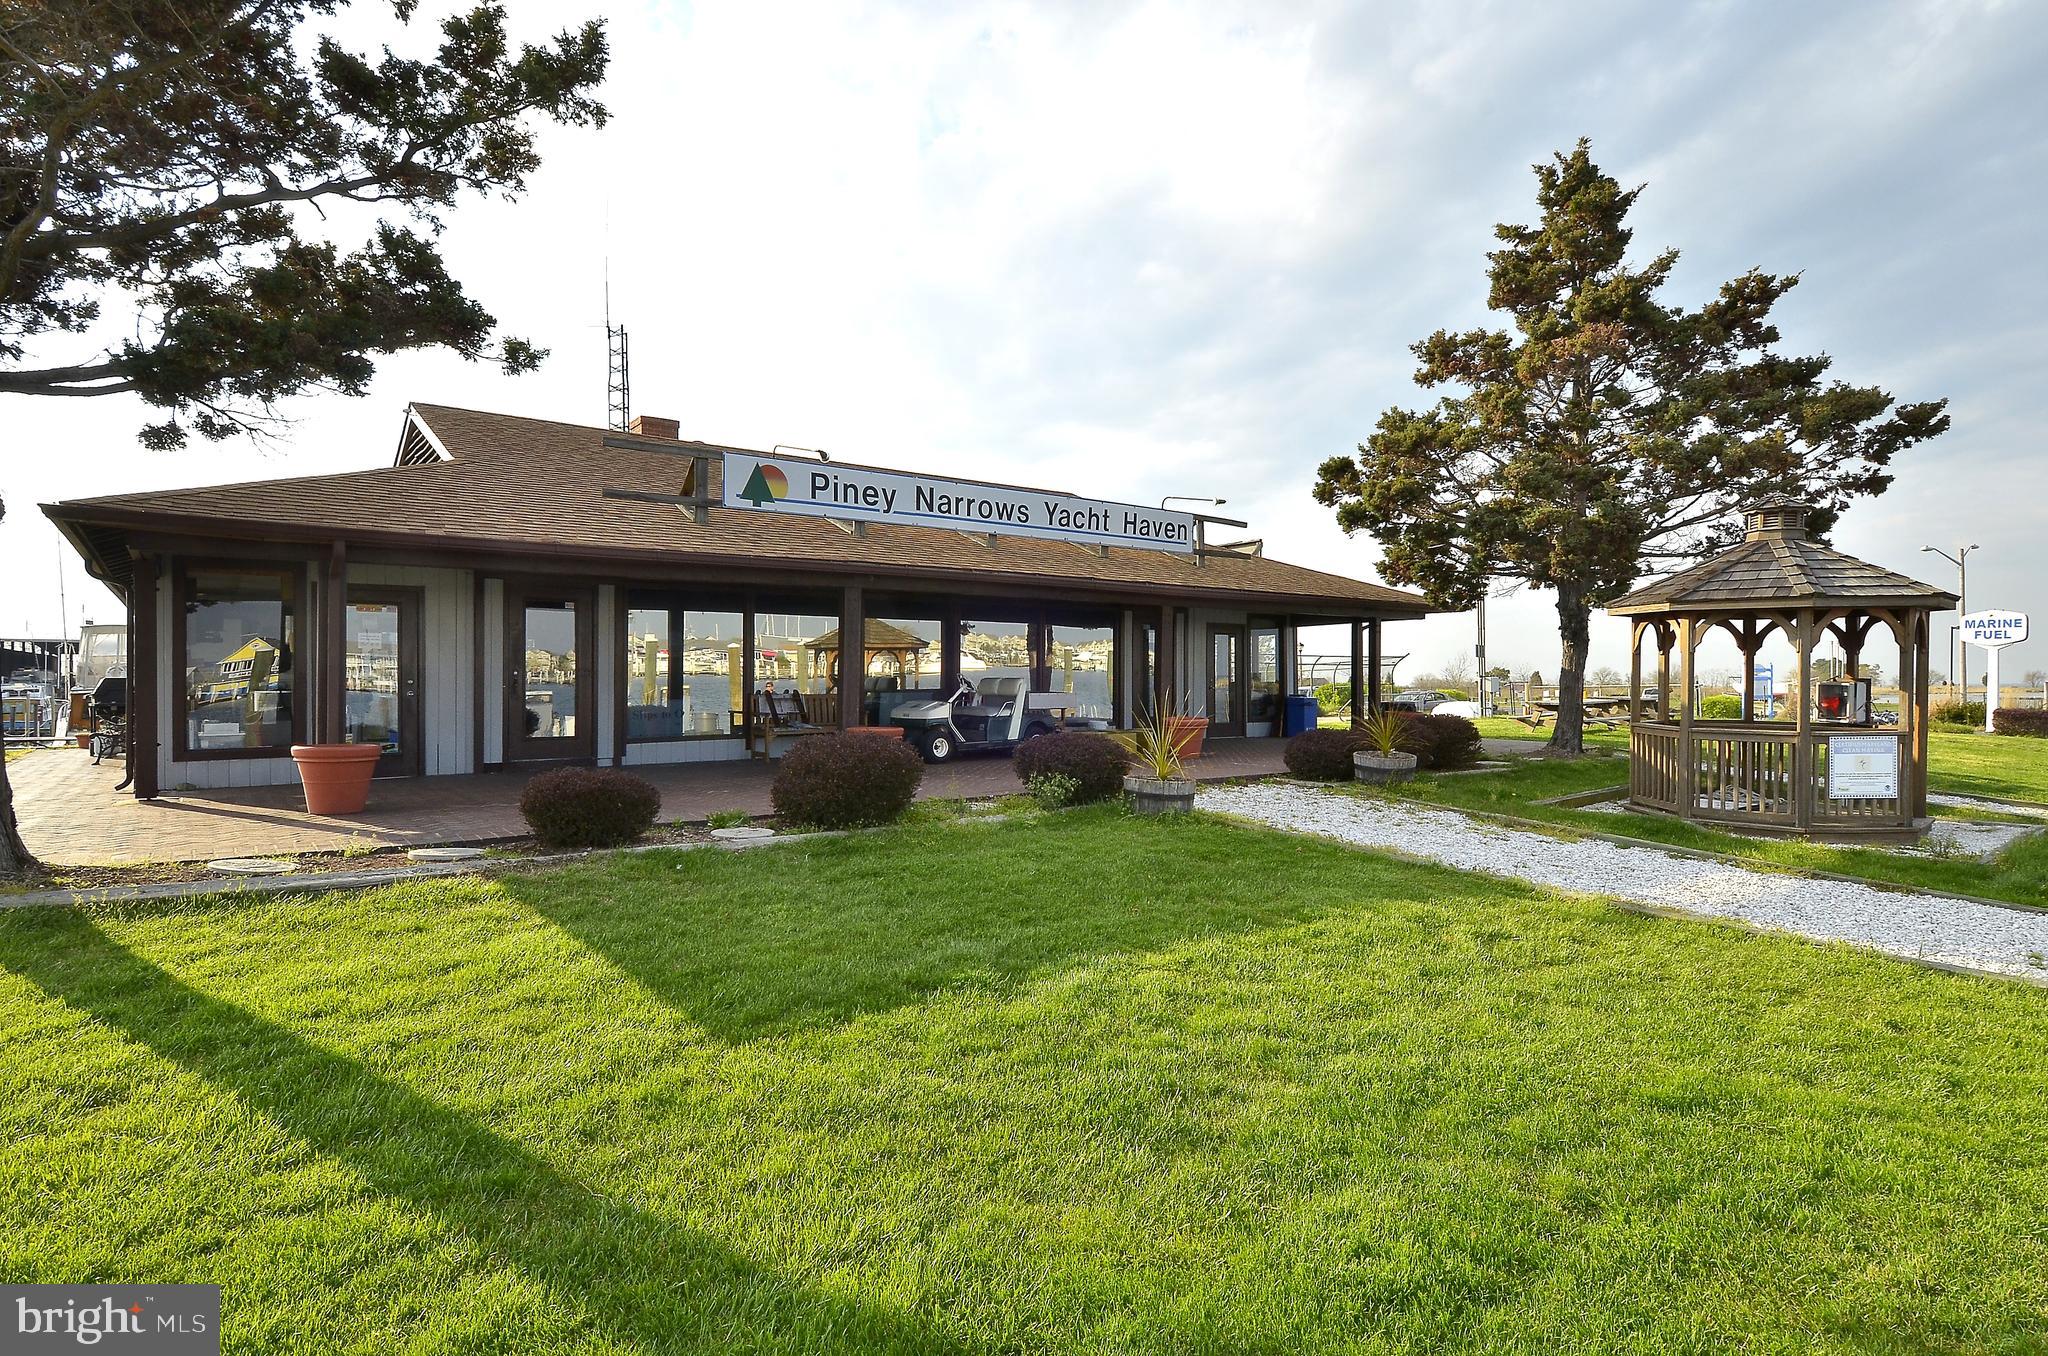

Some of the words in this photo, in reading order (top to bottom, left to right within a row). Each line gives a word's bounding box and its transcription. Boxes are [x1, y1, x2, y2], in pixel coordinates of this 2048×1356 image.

[810, 472, 897, 514] Piney
[915, 485, 1030, 524] Narrows
[1043, 501, 1110, 532] Yacht
[1123, 511, 1188, 541] Haven
[1965, 619, 2022, 628] MARINE
[1974, 630, 2011, 639] FUEL
